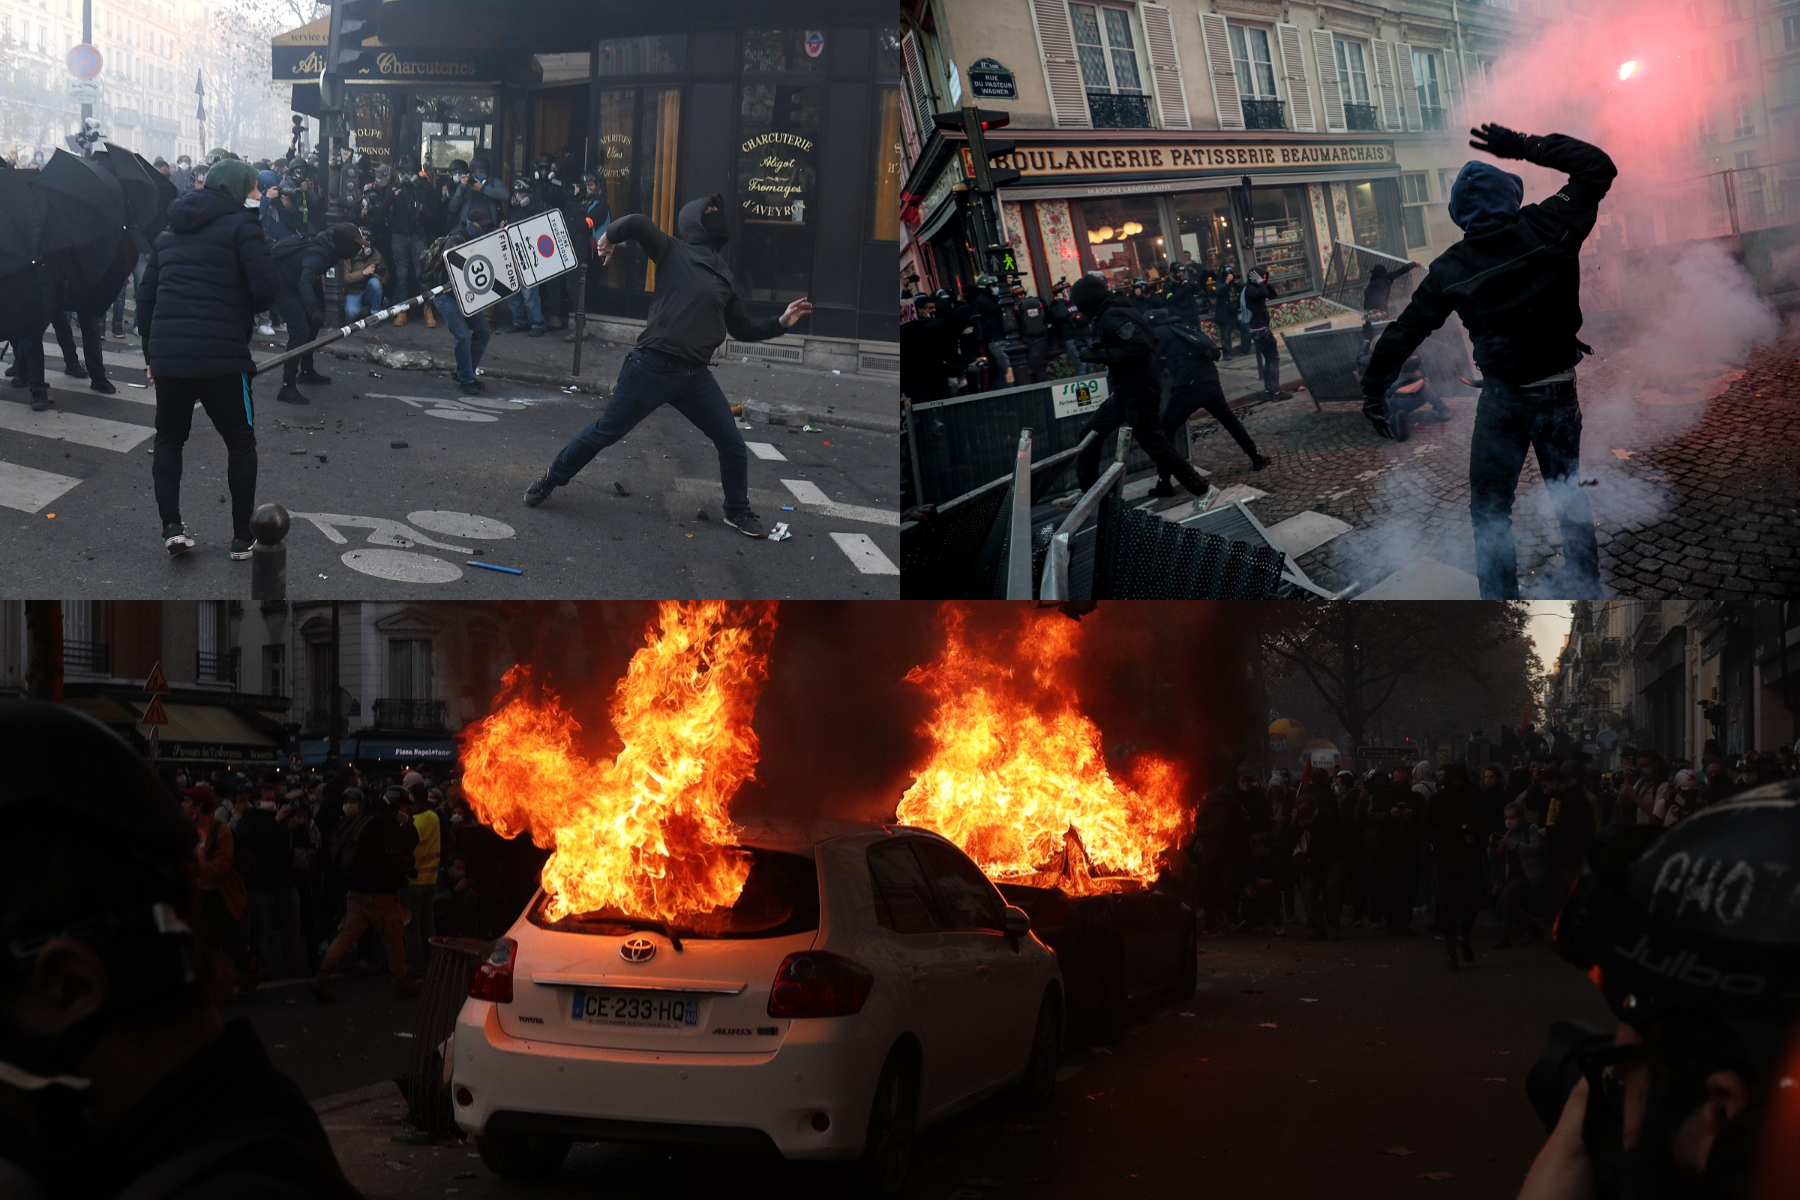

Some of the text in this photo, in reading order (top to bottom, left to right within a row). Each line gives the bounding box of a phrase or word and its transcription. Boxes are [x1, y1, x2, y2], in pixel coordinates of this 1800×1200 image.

[291, 32, 320, 41] service
[377, 52, 475, 75] Charcuteries
[355, 128, 383, 139] OUPE
[742, 132, 814, 153] CHARCUTERIE
[759, 155, 796, 173] Aligot
[1171, 148, 1275, 166] PATISSERIE
[1281, 146, 1384, 164] BEAUMARCHAIS
[748, 178, 802, 198] Fromages
[1087, 184, 1172, 195] MAISON LANDEMAINE
[551, 218, 569, 262] TOURISTIQUE
[560, 231, 569, 248] ZONE
[499, 234, 507, 251] FIN
[505, 263, 517, 288] ZONE
[471, 262, 488, 287] 30
[1613, 934, 1767, 995] Julbo
[518, 1016, 544, 1025] TOYOTA
[687, 1014, 696, 1023] 40
